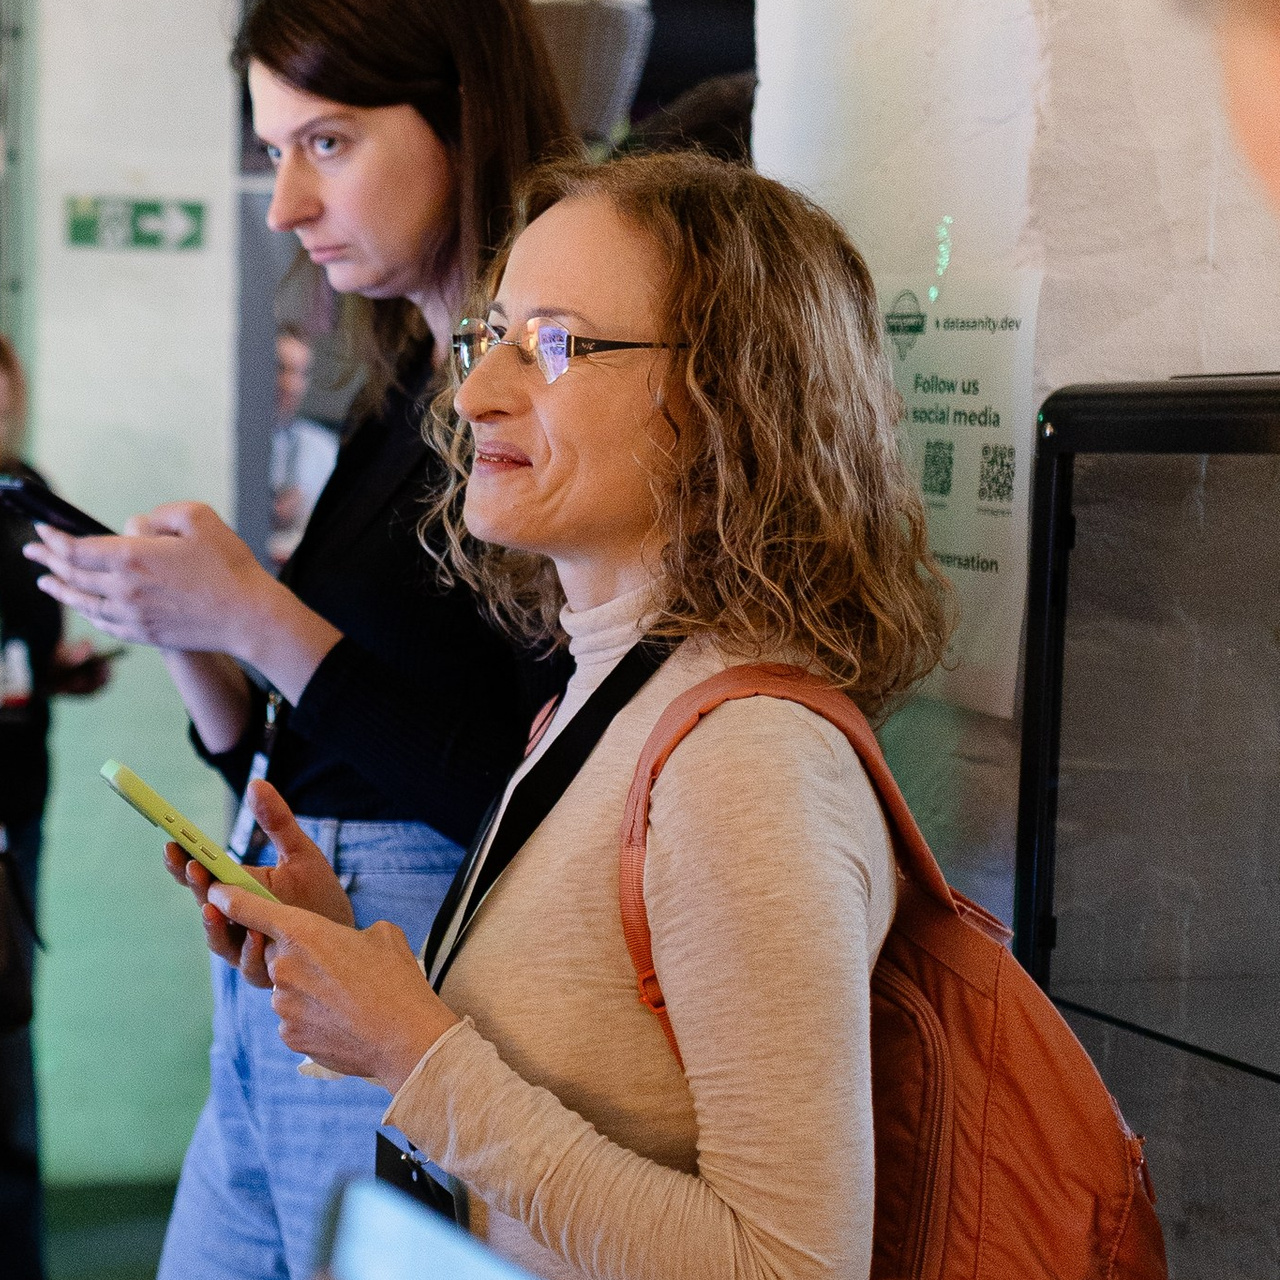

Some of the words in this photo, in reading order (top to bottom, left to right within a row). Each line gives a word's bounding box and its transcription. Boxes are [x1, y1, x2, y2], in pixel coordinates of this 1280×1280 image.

[913, 373, 958, 394] Follow
[961, 380, 980, 395] us
[911, 403, 950, 425] social
[952, 404, 1000, 428] media
